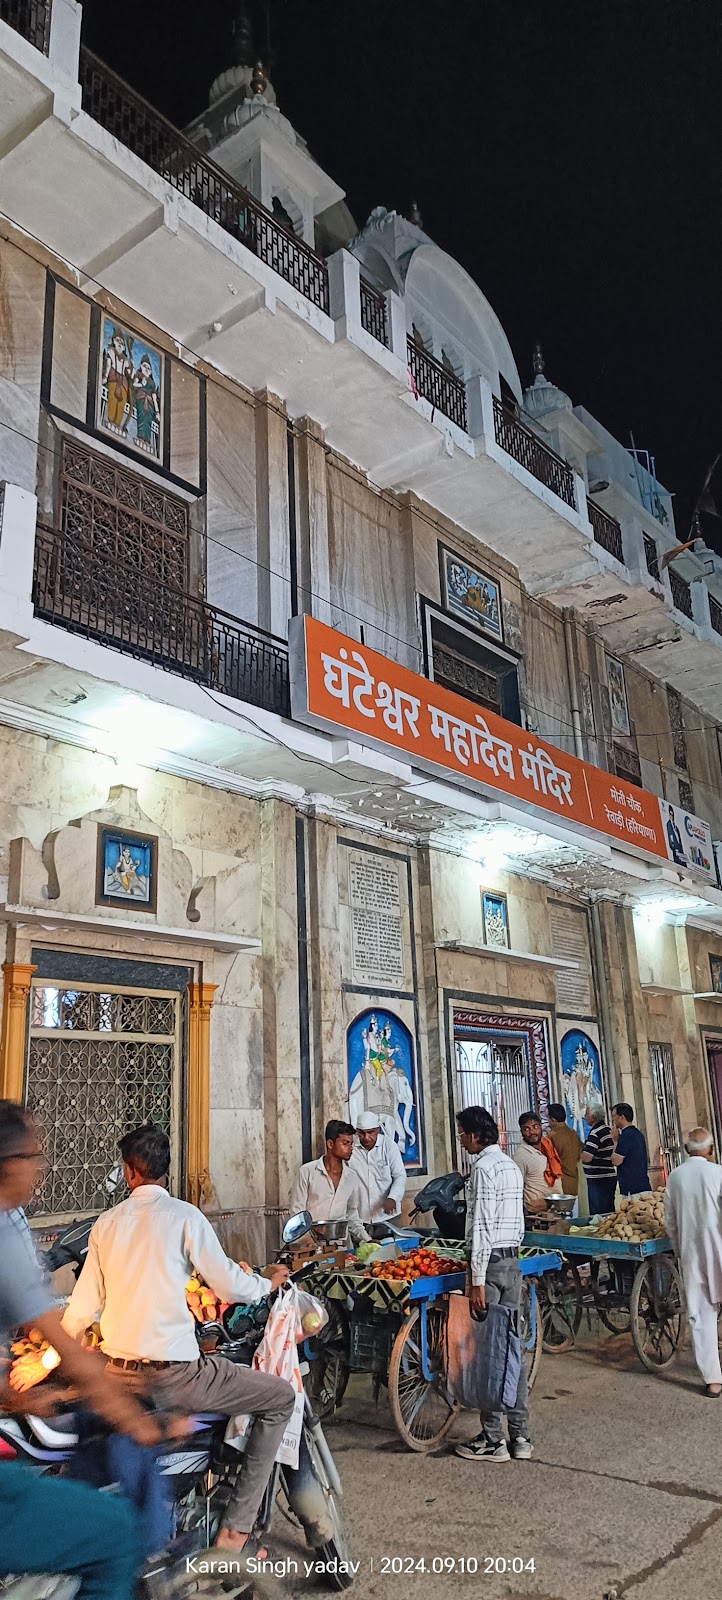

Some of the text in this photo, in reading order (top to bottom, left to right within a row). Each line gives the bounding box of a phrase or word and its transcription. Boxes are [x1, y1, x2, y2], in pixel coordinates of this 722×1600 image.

[320, 647, 574, 806] घंटेश्वर महादेव मंदिर
[609, 785, 645, 818] मोती चौक,
[603, 803, 625, 830] रेवाड़ी
[625, 817, 657, 844] (हरियाणा)
